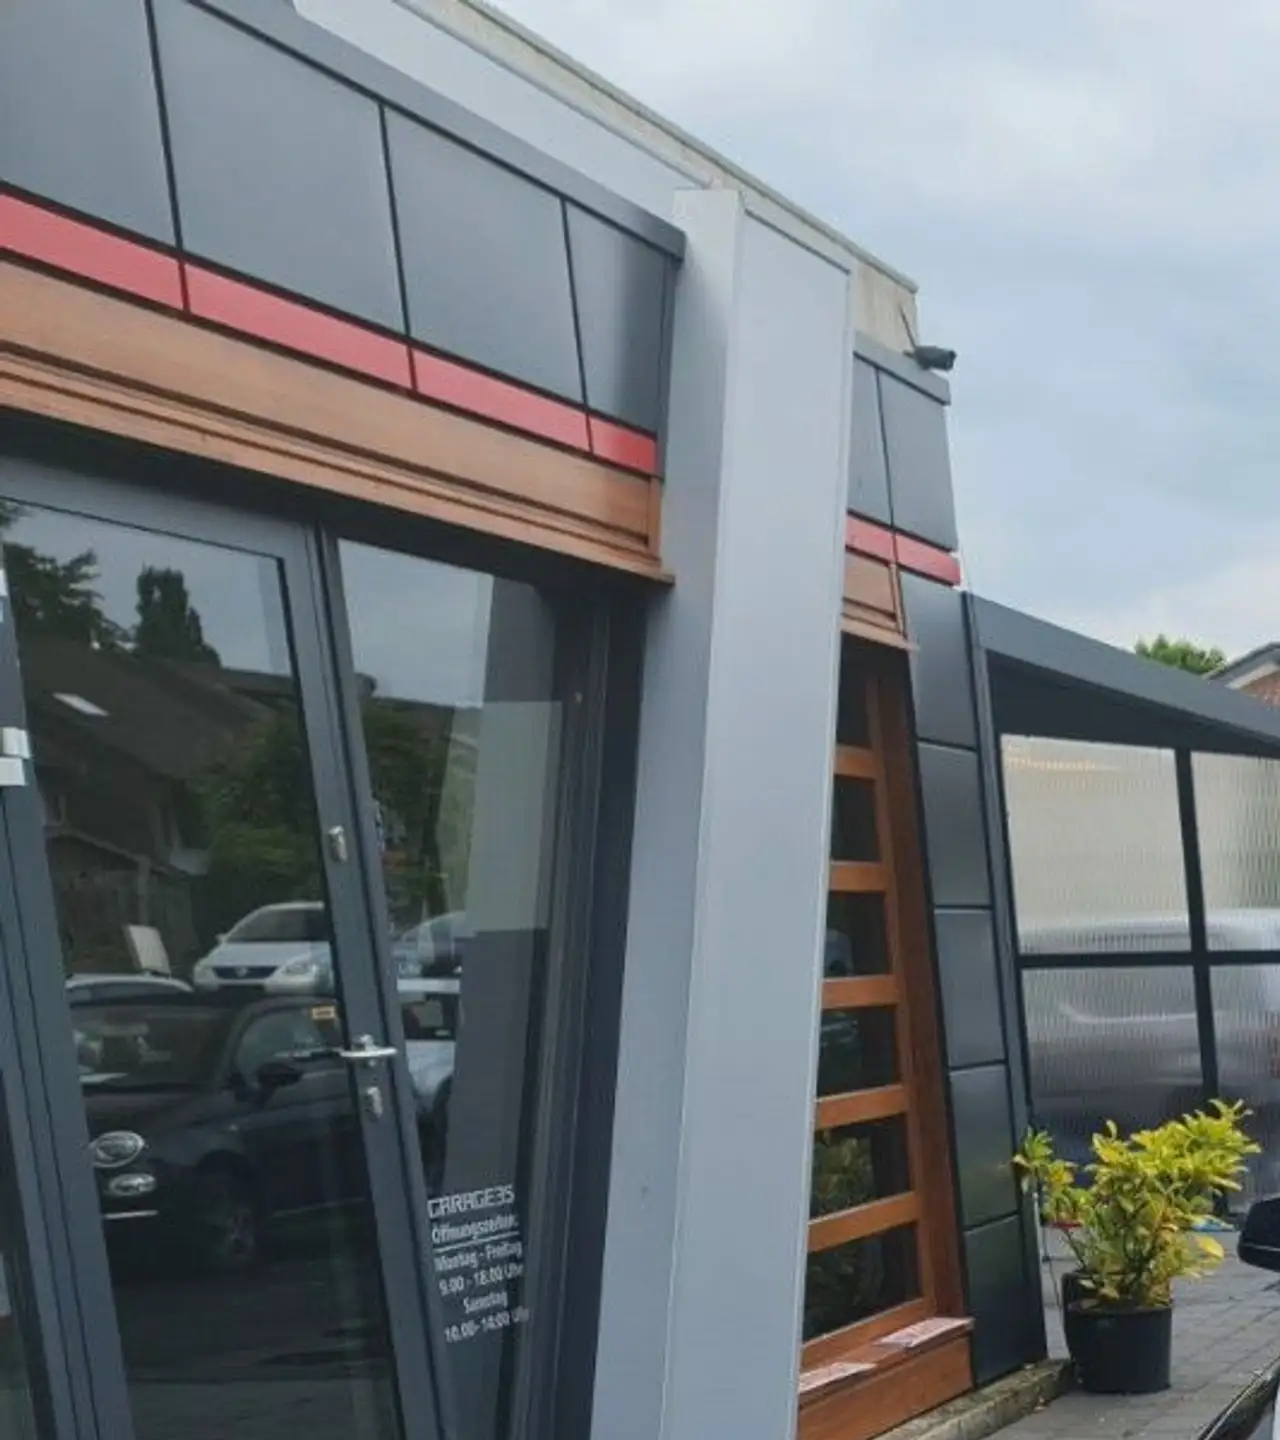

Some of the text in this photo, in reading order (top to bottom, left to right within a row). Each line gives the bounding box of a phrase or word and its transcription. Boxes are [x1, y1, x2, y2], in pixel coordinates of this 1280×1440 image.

[427, 1185, 514, 1217] GARAGE35
[434, 1252, 478, 1271] Montag
[486, 1241, 522, 1260] Freitag
[504, 1263, 524, 1279] Uhr
[463, 1291, 508, 1313] Samstag
